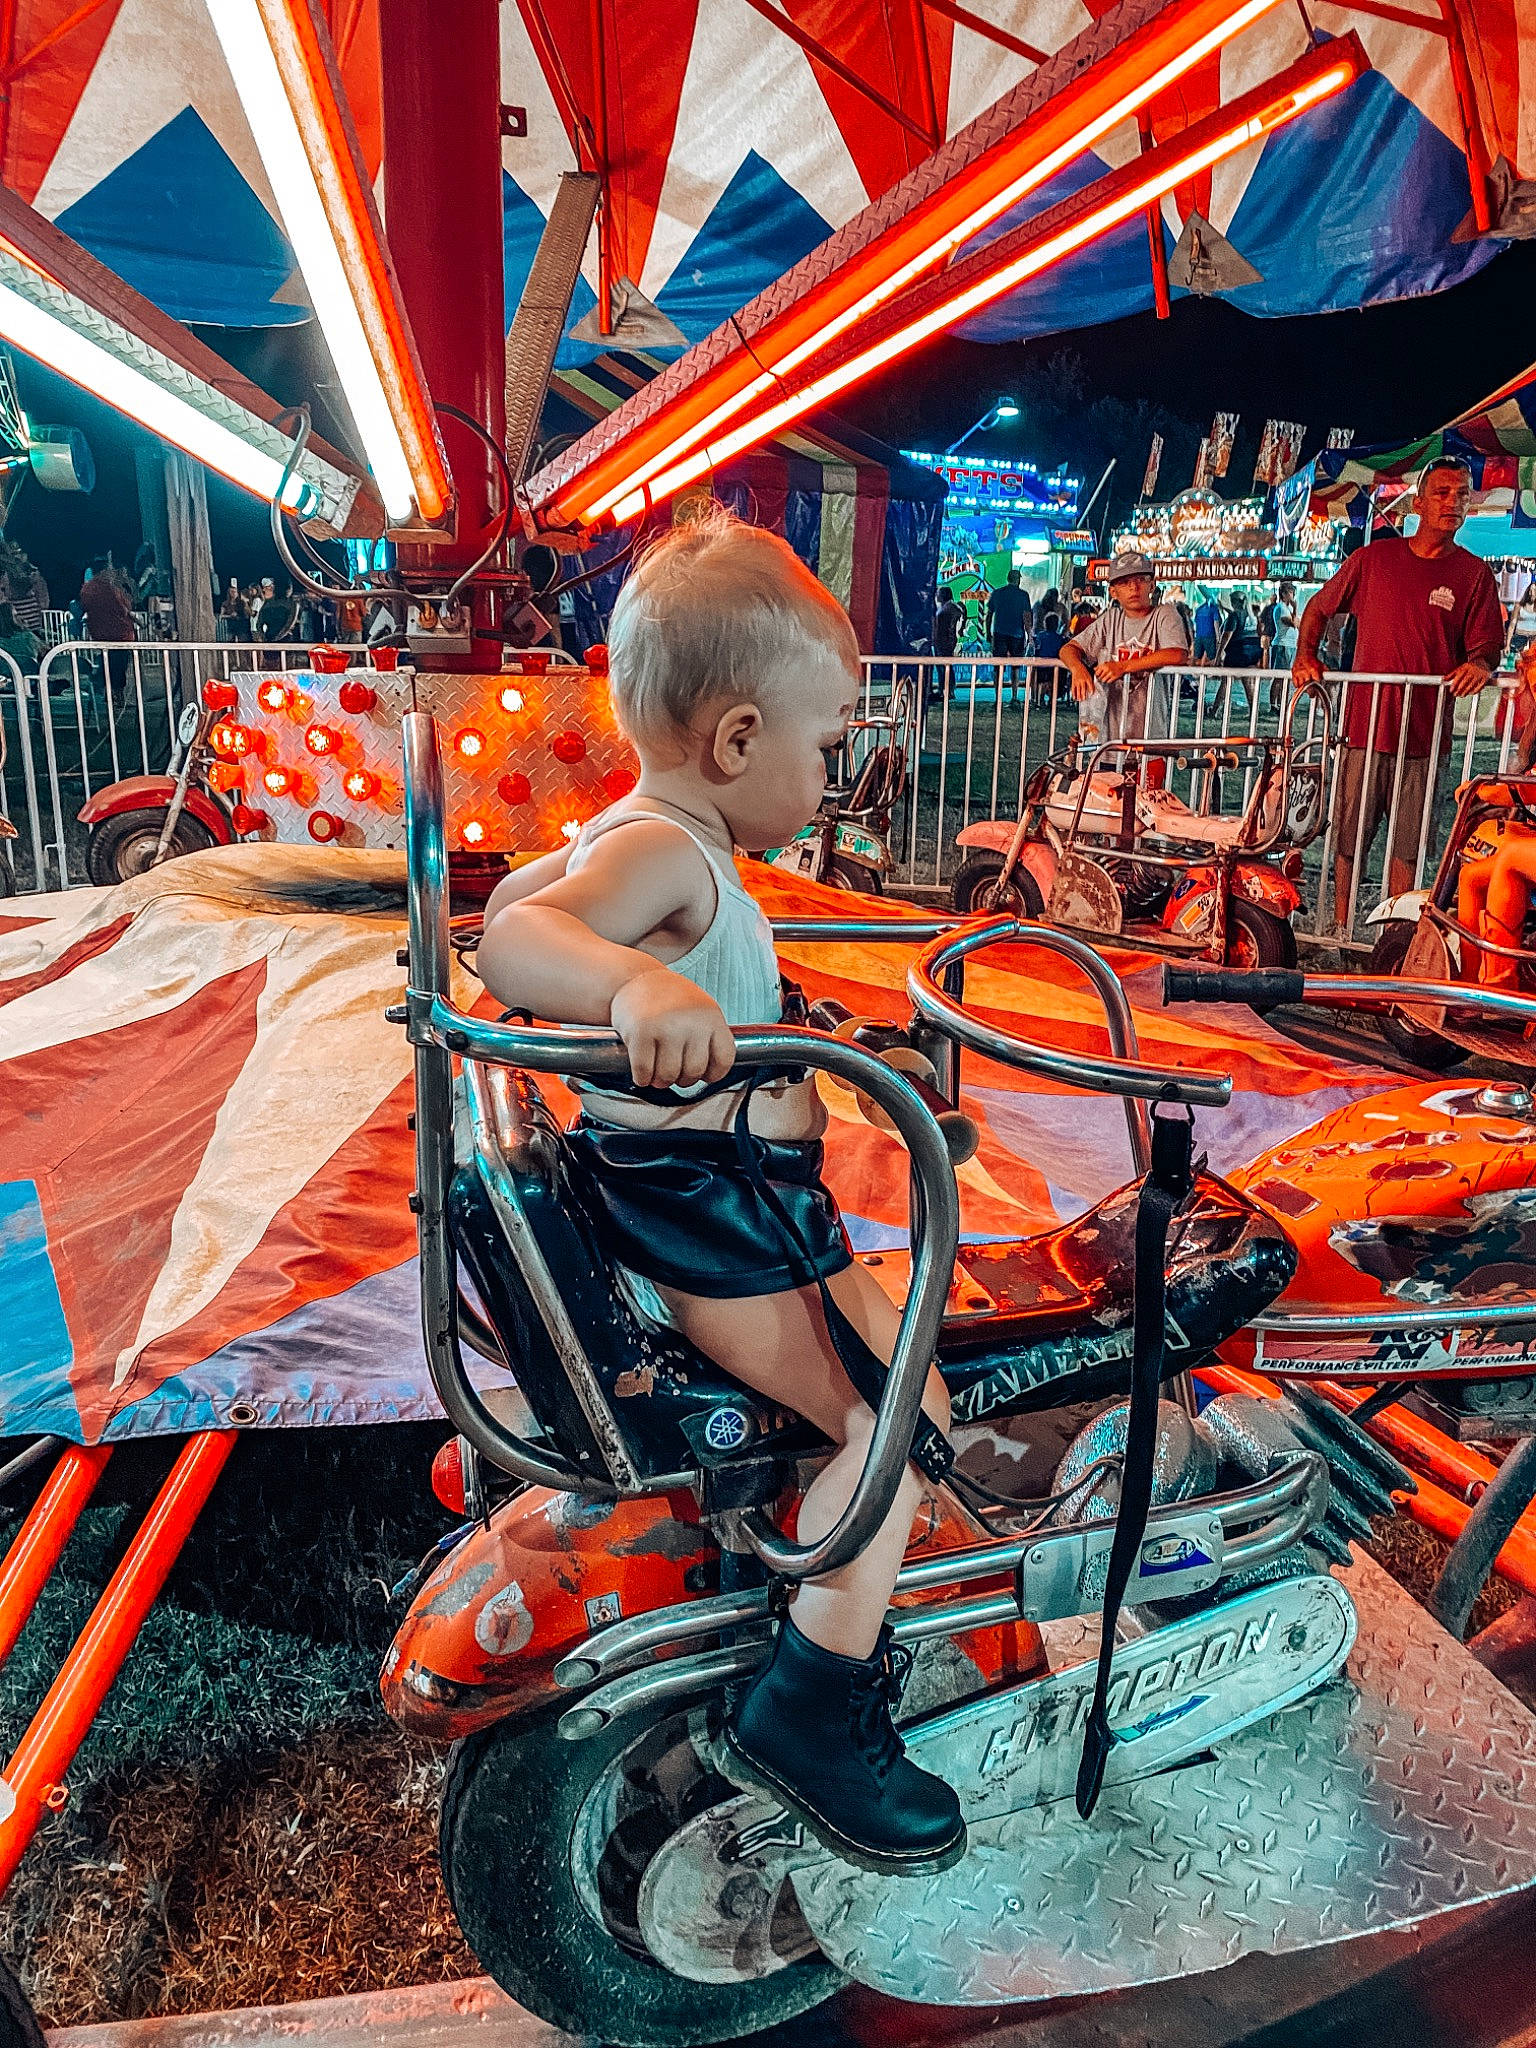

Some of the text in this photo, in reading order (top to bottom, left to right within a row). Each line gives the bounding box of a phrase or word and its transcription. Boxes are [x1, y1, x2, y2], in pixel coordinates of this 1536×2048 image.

[1196, 561, 1259, 577] SAUSAGES
[1260, 1358, 1363, 1371] PERFORMANCE
[977, 1608, 1238, 1774] HAMPTON
